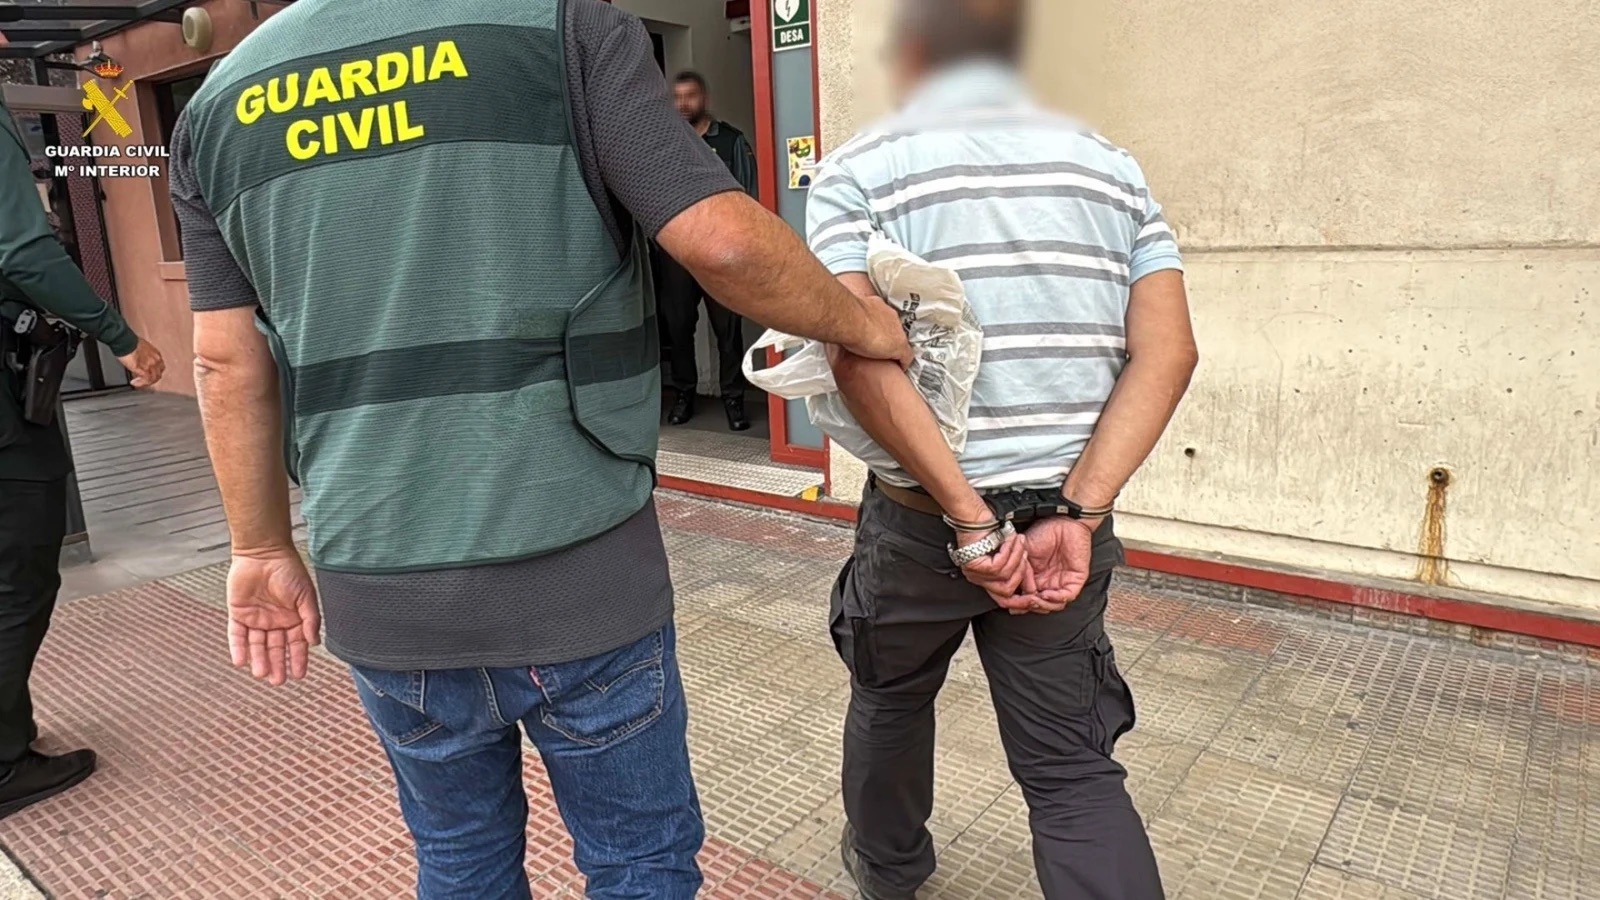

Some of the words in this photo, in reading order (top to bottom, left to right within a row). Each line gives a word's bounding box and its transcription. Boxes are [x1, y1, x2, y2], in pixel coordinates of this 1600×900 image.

[780, 28, 804, 44] DESA
[236, 40, 468, 124] GUARDIA
[286, 100, 424, 160] CIVIL
